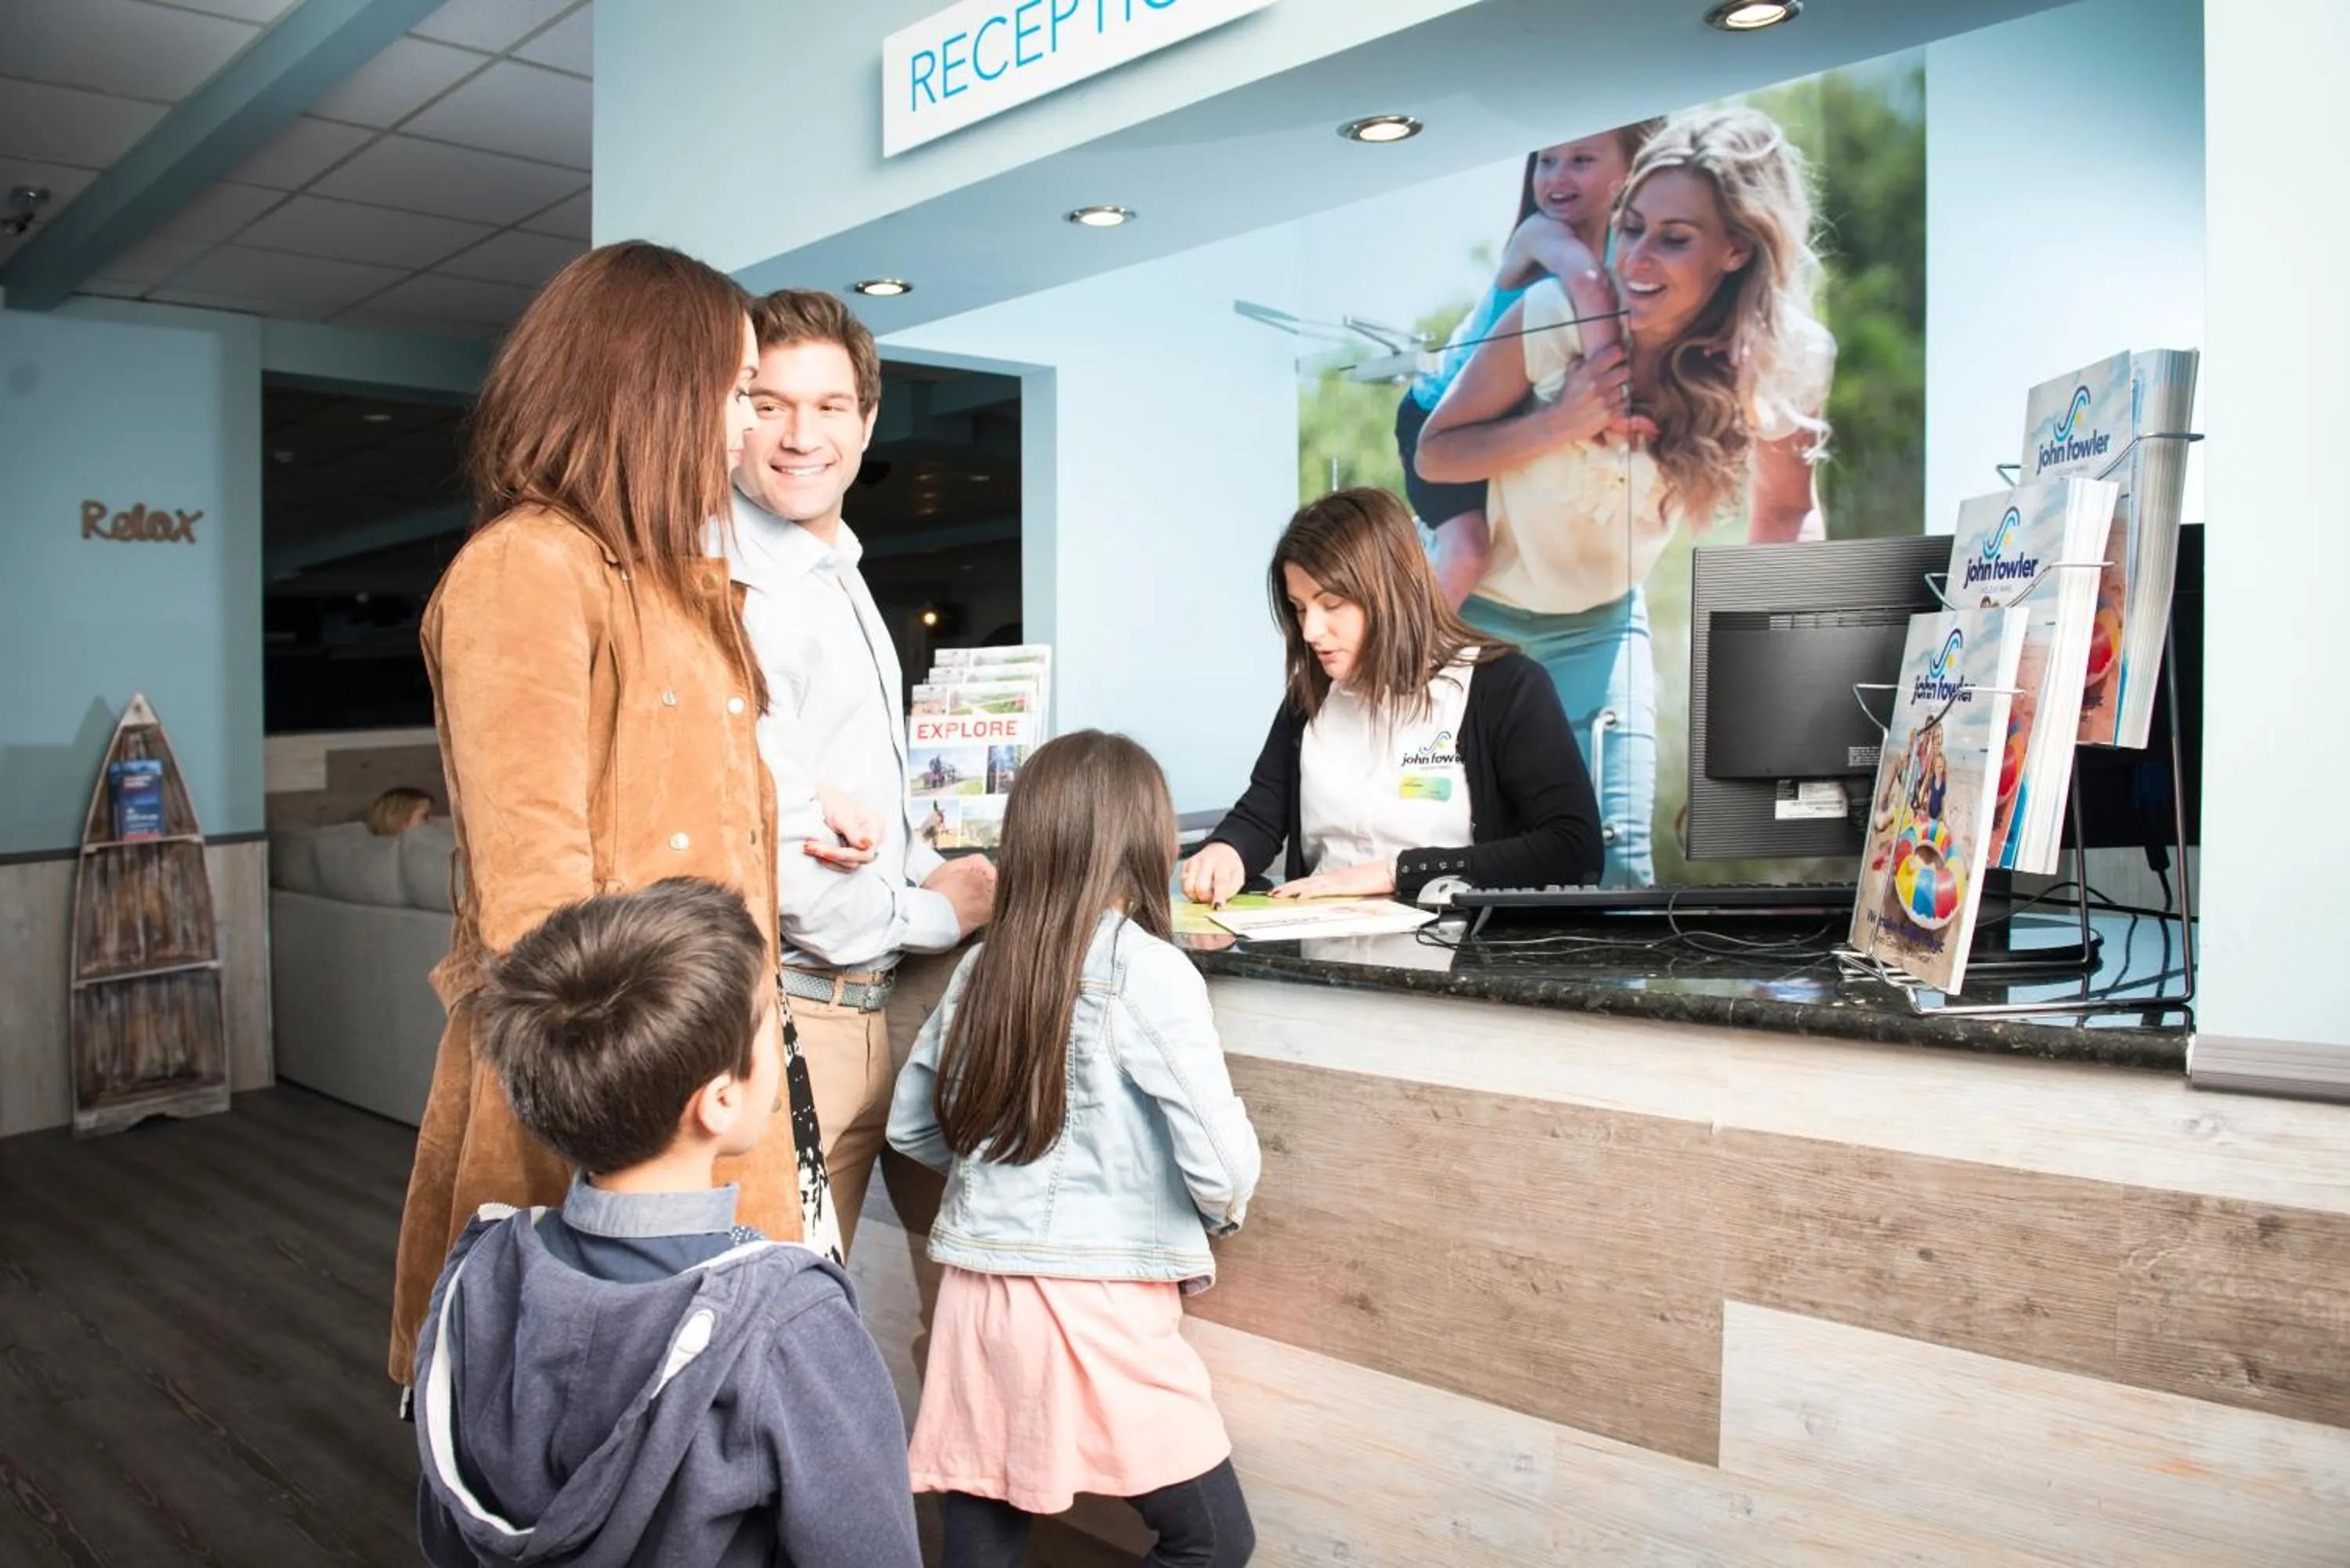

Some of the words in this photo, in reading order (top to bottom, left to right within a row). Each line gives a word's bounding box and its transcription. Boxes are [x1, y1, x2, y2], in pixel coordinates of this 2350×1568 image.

[911, 0, 1175, 111] RECEP
[2036, 439, 2065, 476] john
[2066, 428, 2110, 461] fowler
[81, 499, 204, 544] Relax
[1963, 556, 1992, 589] john
[1993, 551, 2038, 580] fowler
[916, 720, 1019, 739] EXPLORE
[1401, 753, 1429, 767] john
